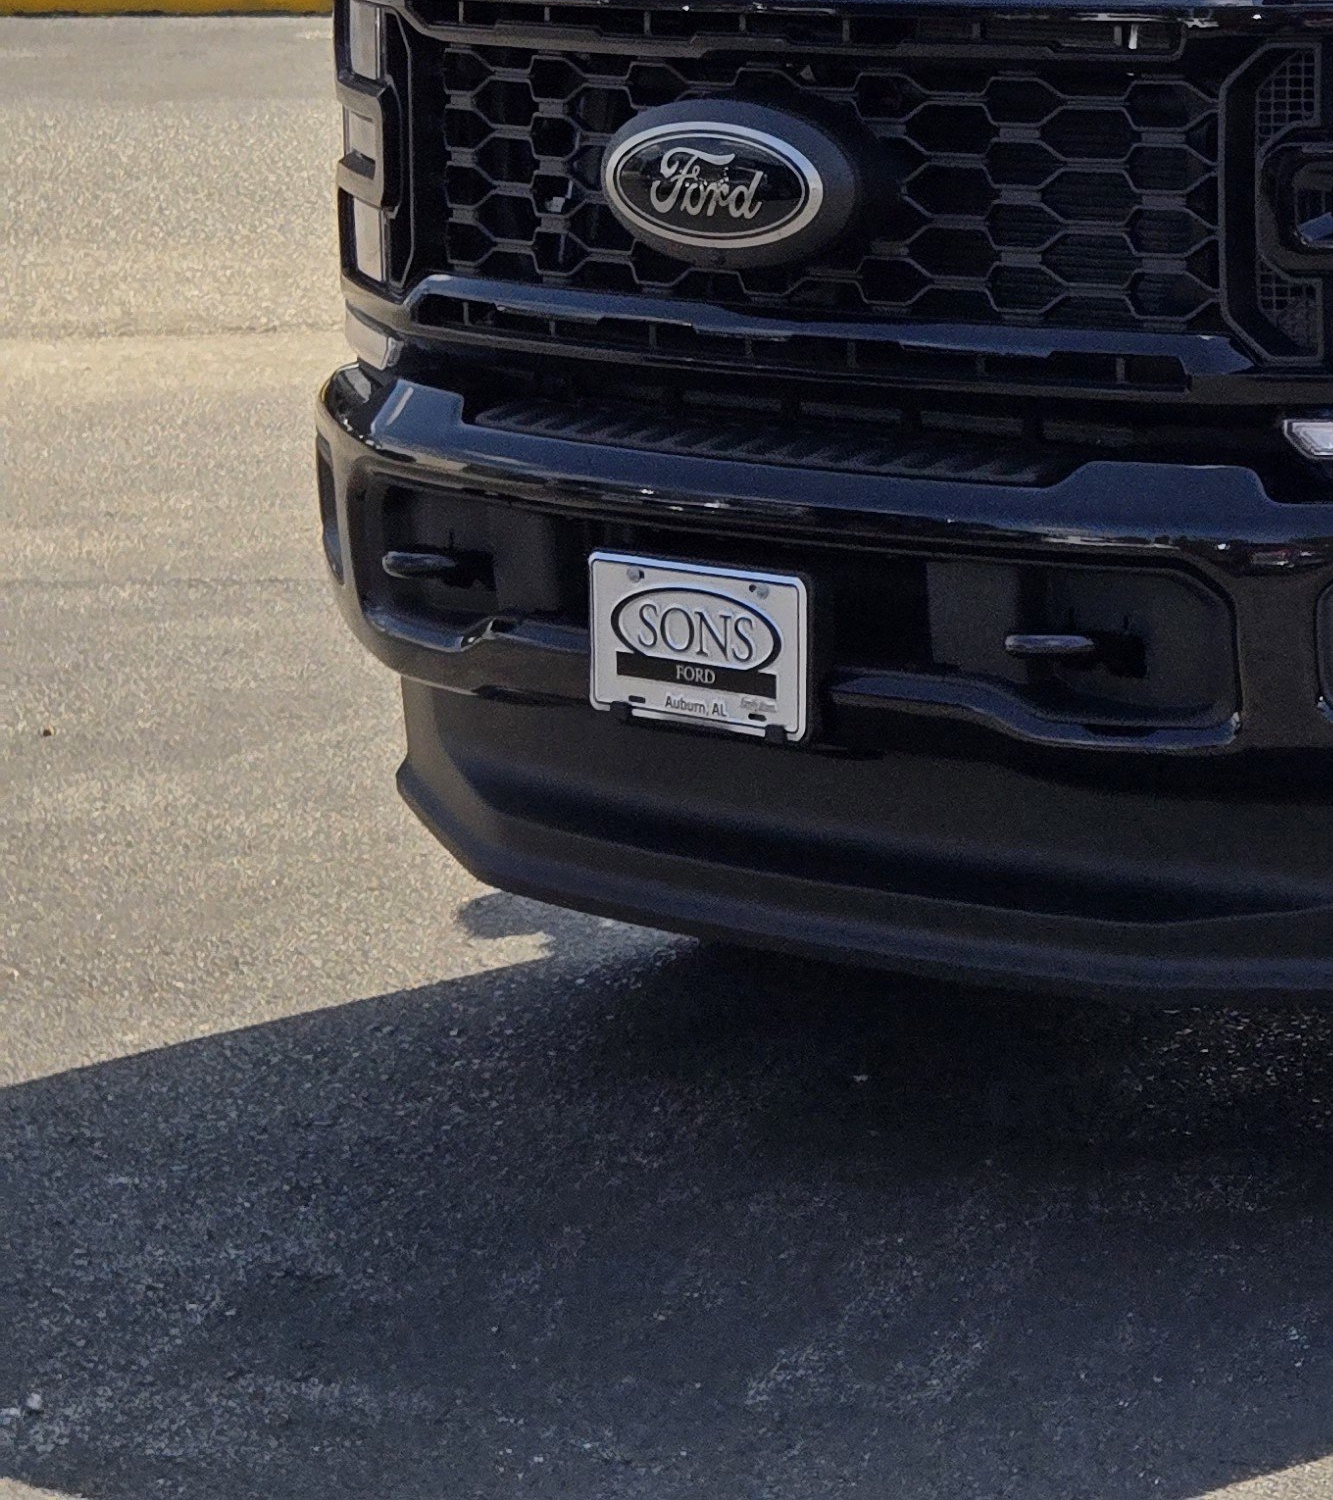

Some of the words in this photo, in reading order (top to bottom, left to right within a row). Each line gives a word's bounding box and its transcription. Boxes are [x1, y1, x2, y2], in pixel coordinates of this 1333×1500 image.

[650, 146, 764, 220] Ford
[637, 603, 753, 662] SONS
[675, 664, 716, 684] FORD
[712, 702, 727, 717] AL
